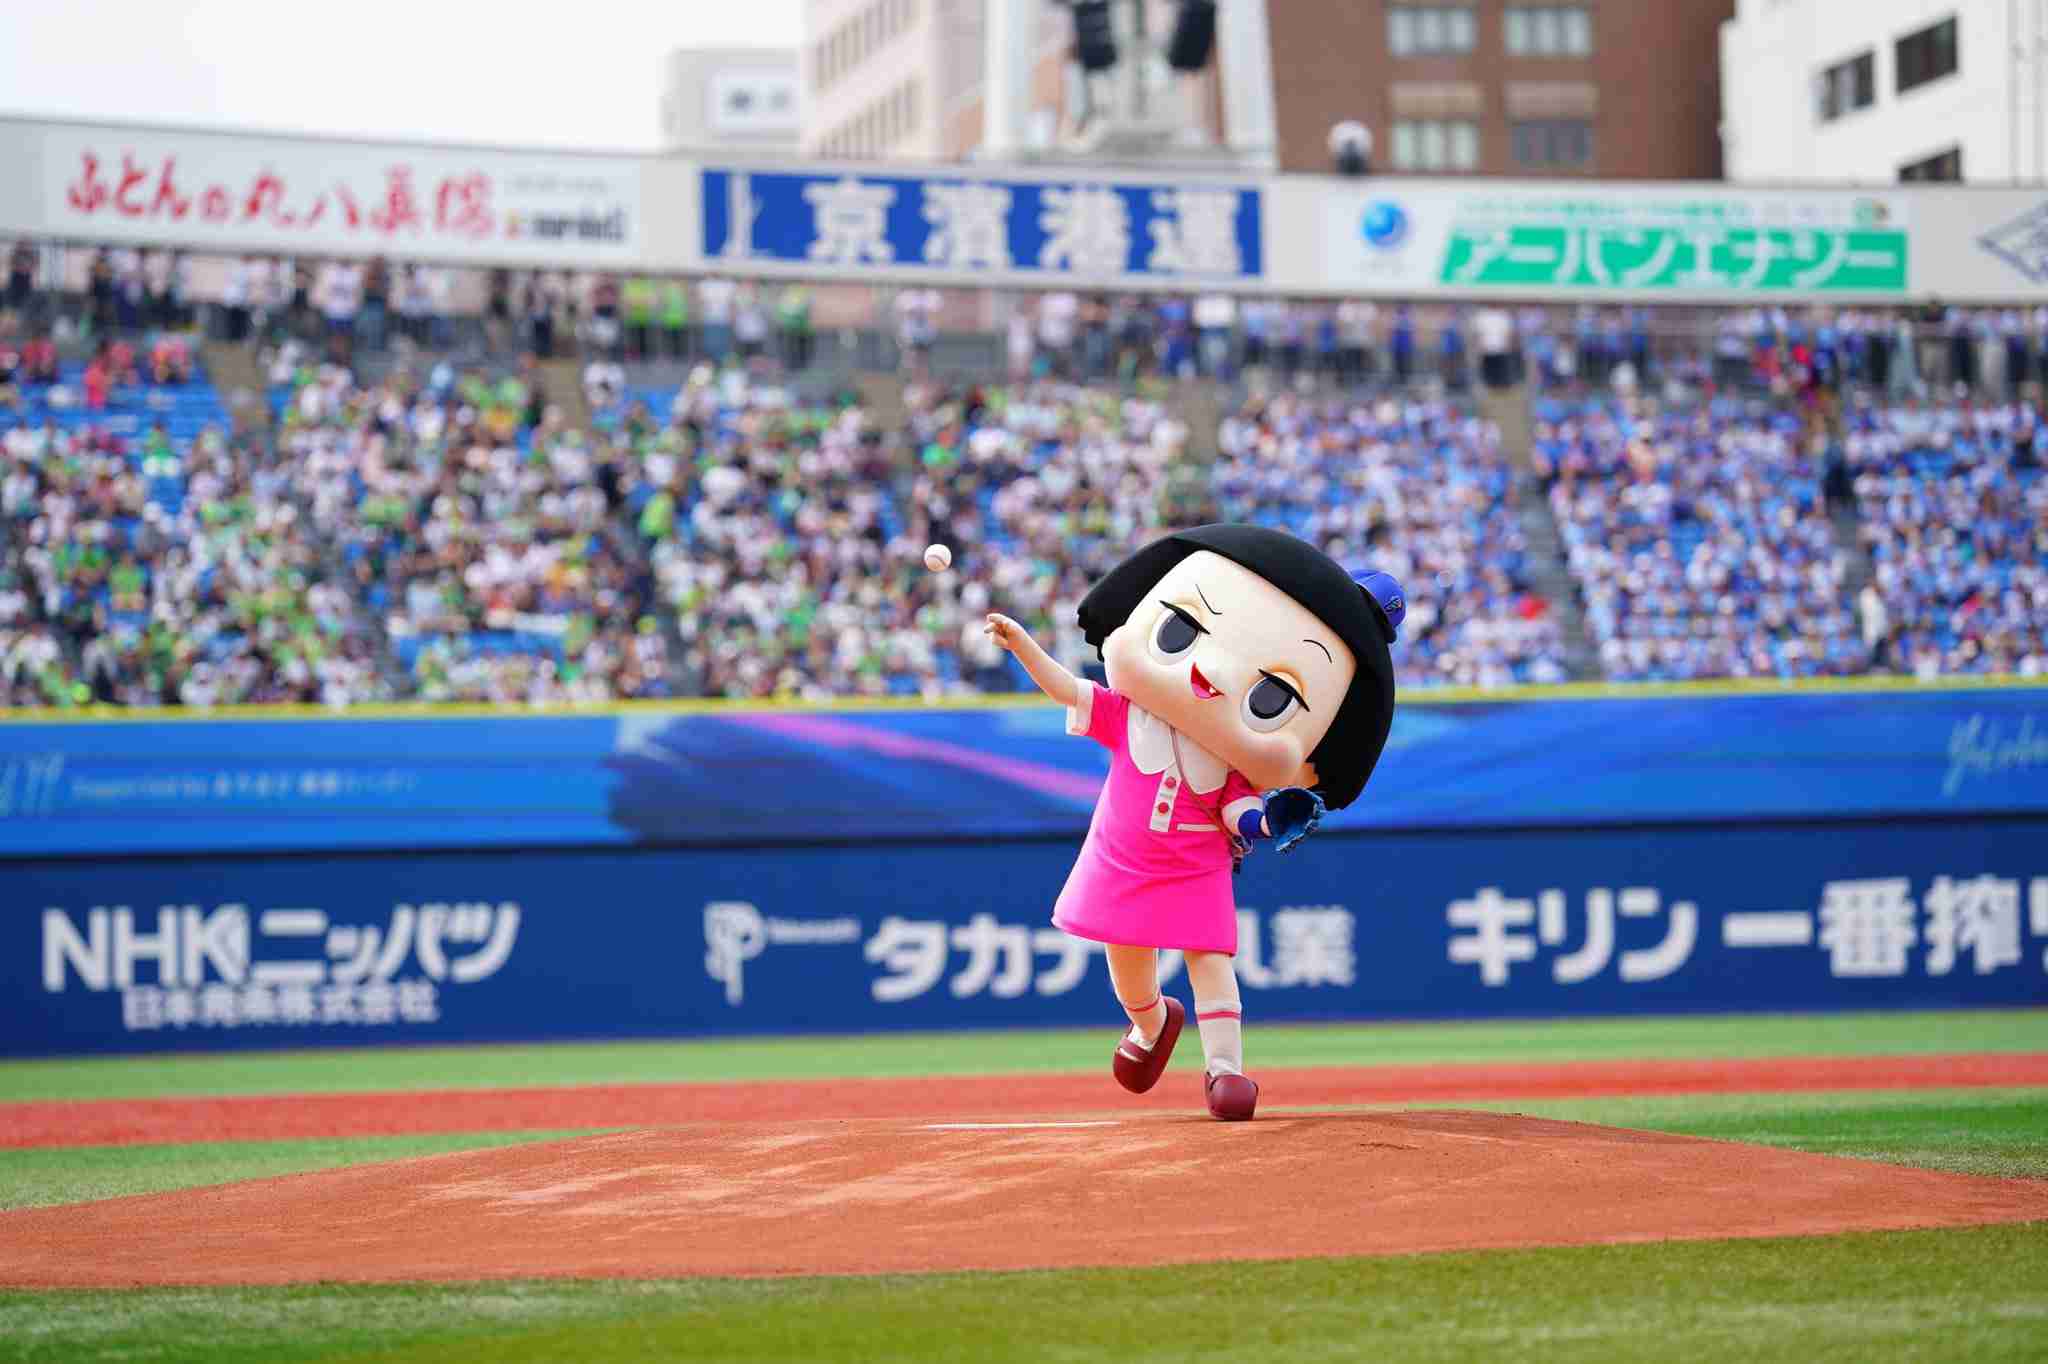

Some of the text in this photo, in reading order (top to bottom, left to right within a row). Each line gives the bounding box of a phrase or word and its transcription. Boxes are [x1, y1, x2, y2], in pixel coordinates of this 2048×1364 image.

[43, 903, 520, 992] NHKニッパツ
[863, 903, 1356, 1001] タカナ業
[1447, 888, 1698, 984] キリン
